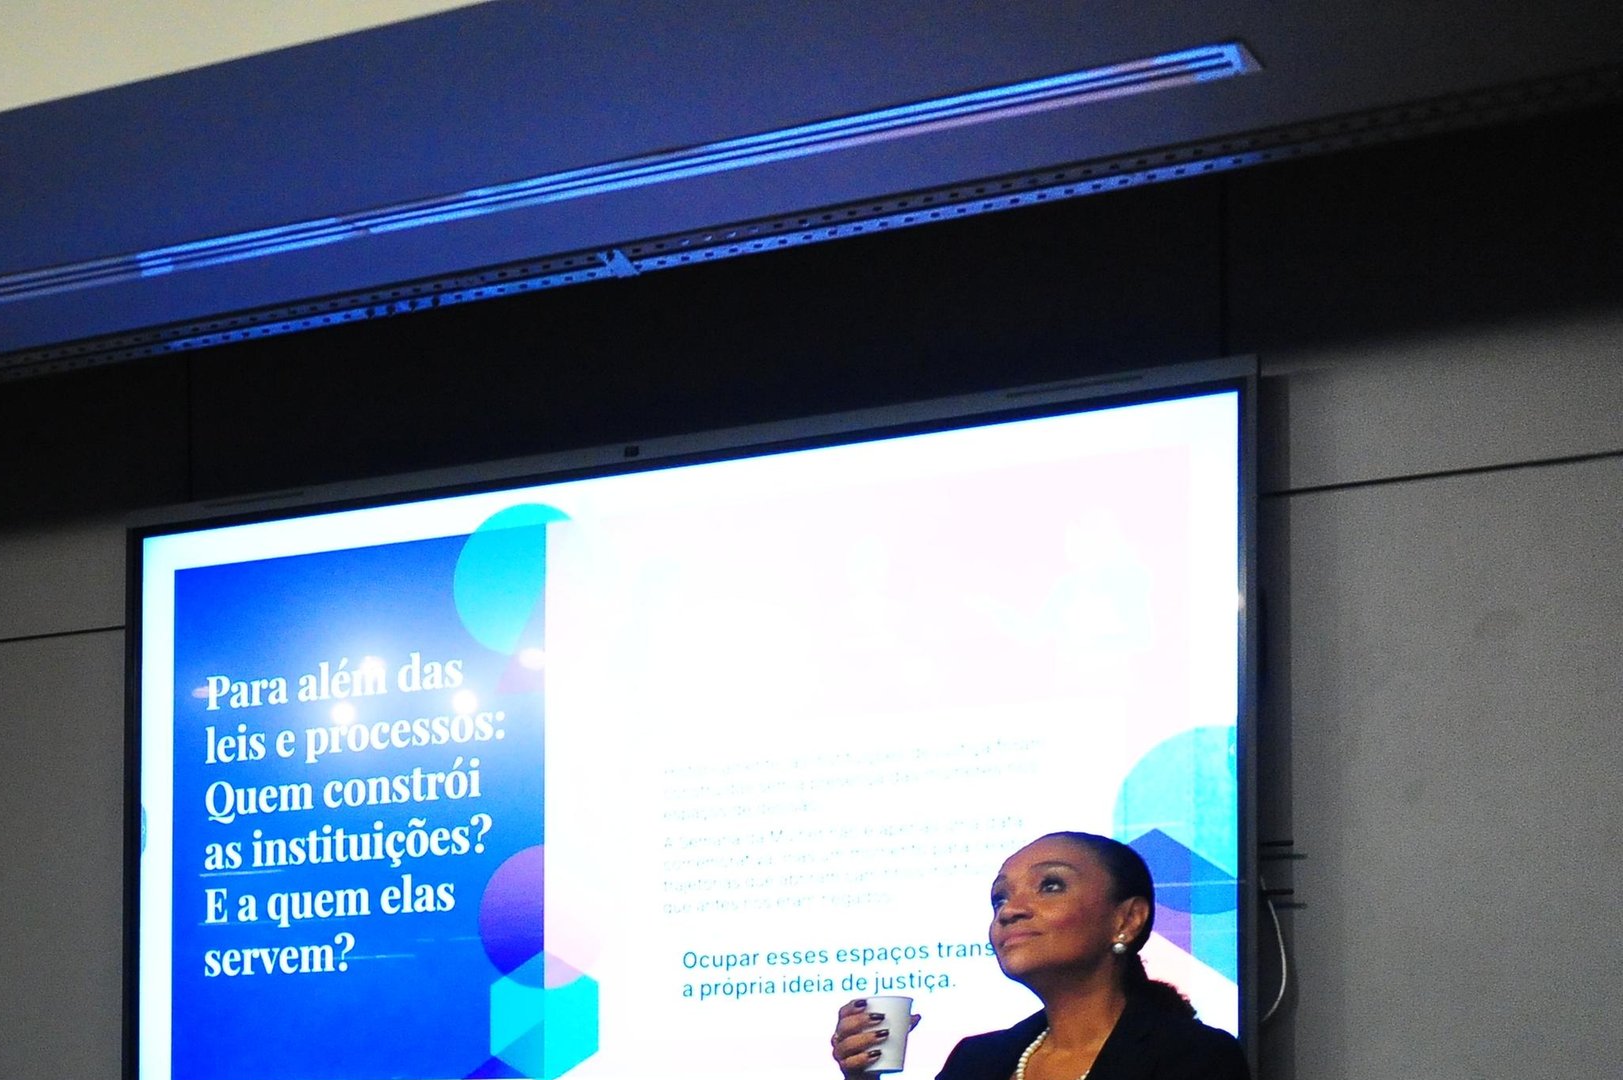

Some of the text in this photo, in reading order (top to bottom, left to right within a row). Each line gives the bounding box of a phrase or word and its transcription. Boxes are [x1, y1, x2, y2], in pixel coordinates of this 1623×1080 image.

[206, 651, 464, 711] Para além das
[205, 710, 505, 764] leis e processos:
[205, 756, 482, 824] Quem constrói
[204, 813, 493, 871] as instituições?
[204, 873, 456, 928] E a quem elas
[204, 932, 356, 978] servem?
[682, 951, 760, 972] Ocupar
[766, 950, 829, 967] esses
[836, 944, 930, 966] espaços
[682, 969, 956, 1001] a própria ideia de justiça.
